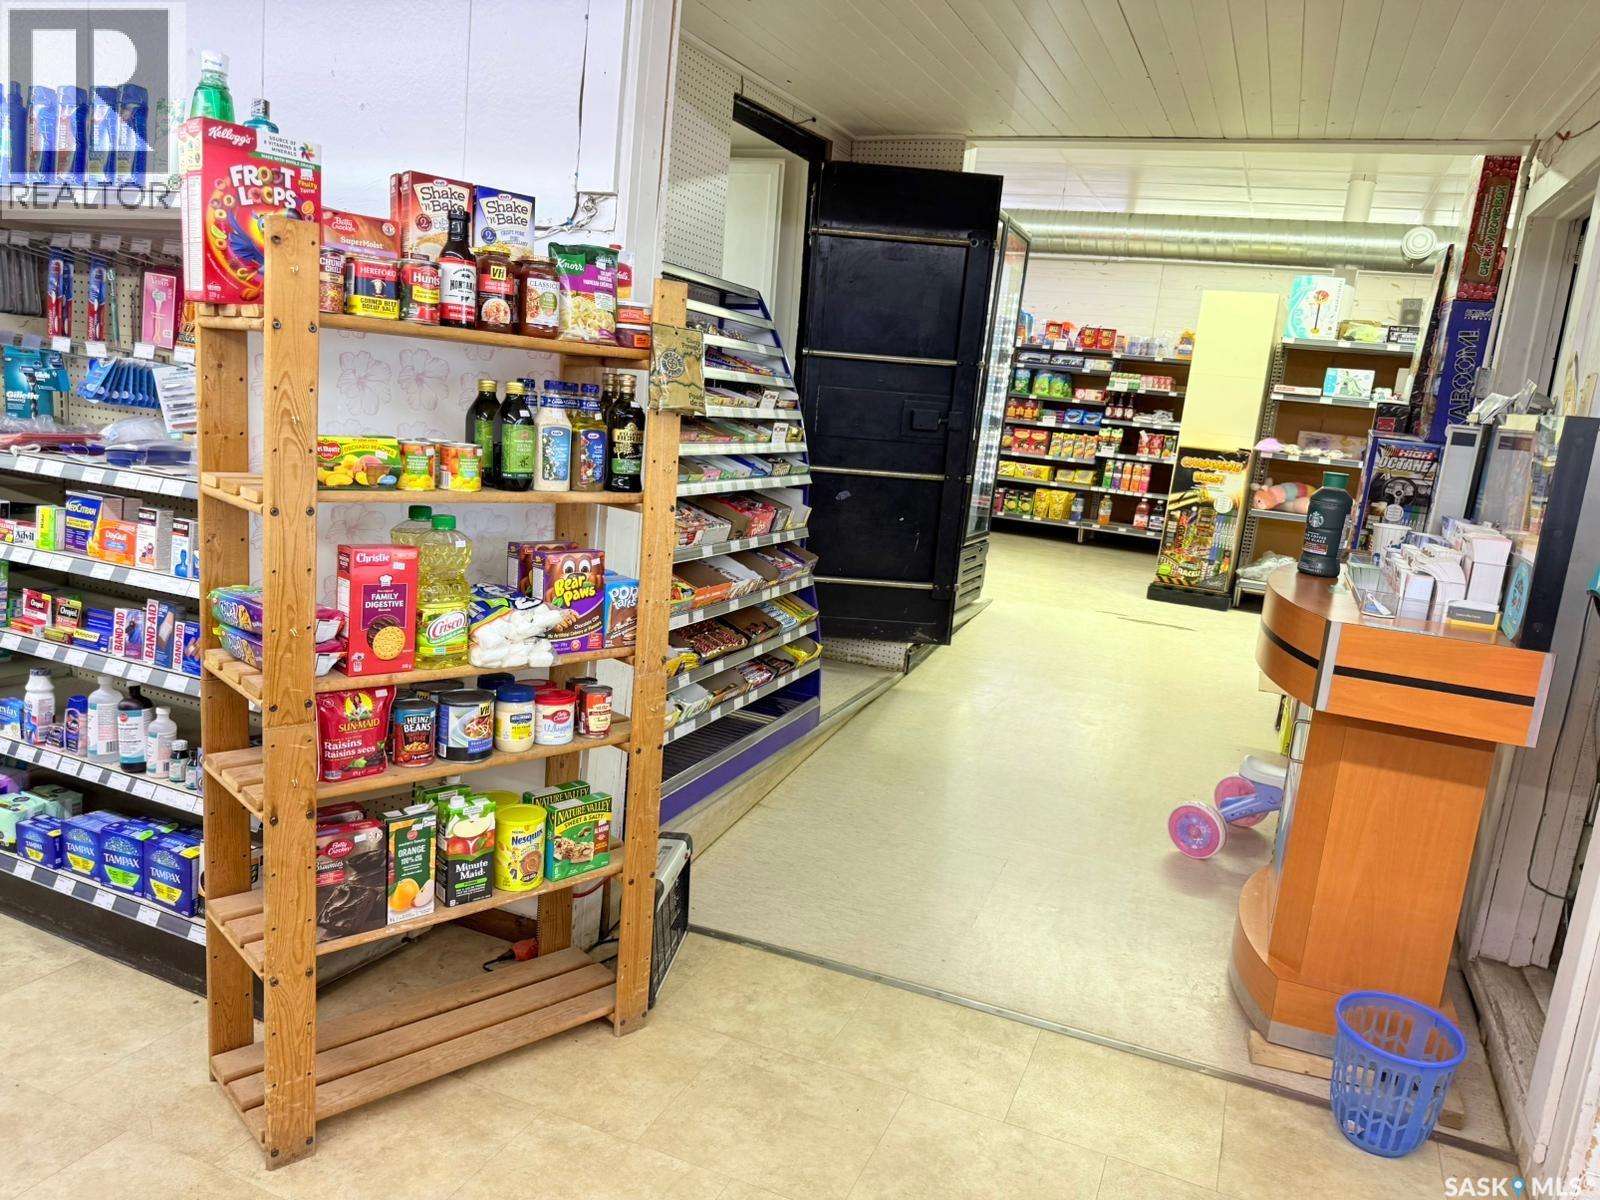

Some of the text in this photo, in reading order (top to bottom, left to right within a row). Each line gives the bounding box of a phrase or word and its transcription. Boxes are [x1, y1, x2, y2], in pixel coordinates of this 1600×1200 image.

[208, 126, 254, 146] Kellogg's
[271, 147, 297, 157] MINERALS
[229, 164, 295, 189] FROOT
[237, 185, 297, 209] LOOPS
[420, 186, 466, 202] Shake
[432, 200, 465, 213] Bake
[485, 200, 529, 216] Shake
[496, 213, 528, 227] Bake
[340, 237, 384, 250] SuperMoist
[555, 257, 585, 272] Knorr
[359, 266, 397, 278] HEREFORD
[491, 267, 506, 279] VH
[360, 297, 383, 307] CORNED
[6, 390, 39, 401] Gillette
[1398, 449, 1433, 460] HIGH
[1378, 456, 1431, 474] OCTANE
[15, 530, 34, 541] Advil
[356, 552, 391, 563] Christie
[554, 575, 586, 598] Bear
[371, 592, 399, 601] FAMILY
[563, 585, 596, 608] Paws
[365, 600, 405, 609] DIGESTIVE
[60, 606, 78, 618] Orajel
[145, 604, 157, 659] BAND-AID
[431, 618, 464, 638] Crisco
[480, 704, 491, 717] VH
[406, 715, 429, 723] HEINZ
[403, 723, 432, 732] BEANS
[324, 739, 362, 750] Raisins
[324, 749, 356, 759] Raisins
[564, 786, 590, 802] VALLEY
[556, 799, 612, 826] NATURE VALLEY
[564, 817, 583, 829] SWEET
[66, 842, 96, 856] TAMPAX
[331, 840, 348, 850] Betty
[397, 844, 426, 858] ORANGE
[327, 846, 353, 858] Crocker
[103, 852, 140, 868] TAMPAX
[455, 859, 489, 874] Minute
[150, 866, 181, 884] TAMPAX
[460, 868, 484, 881] Maid
